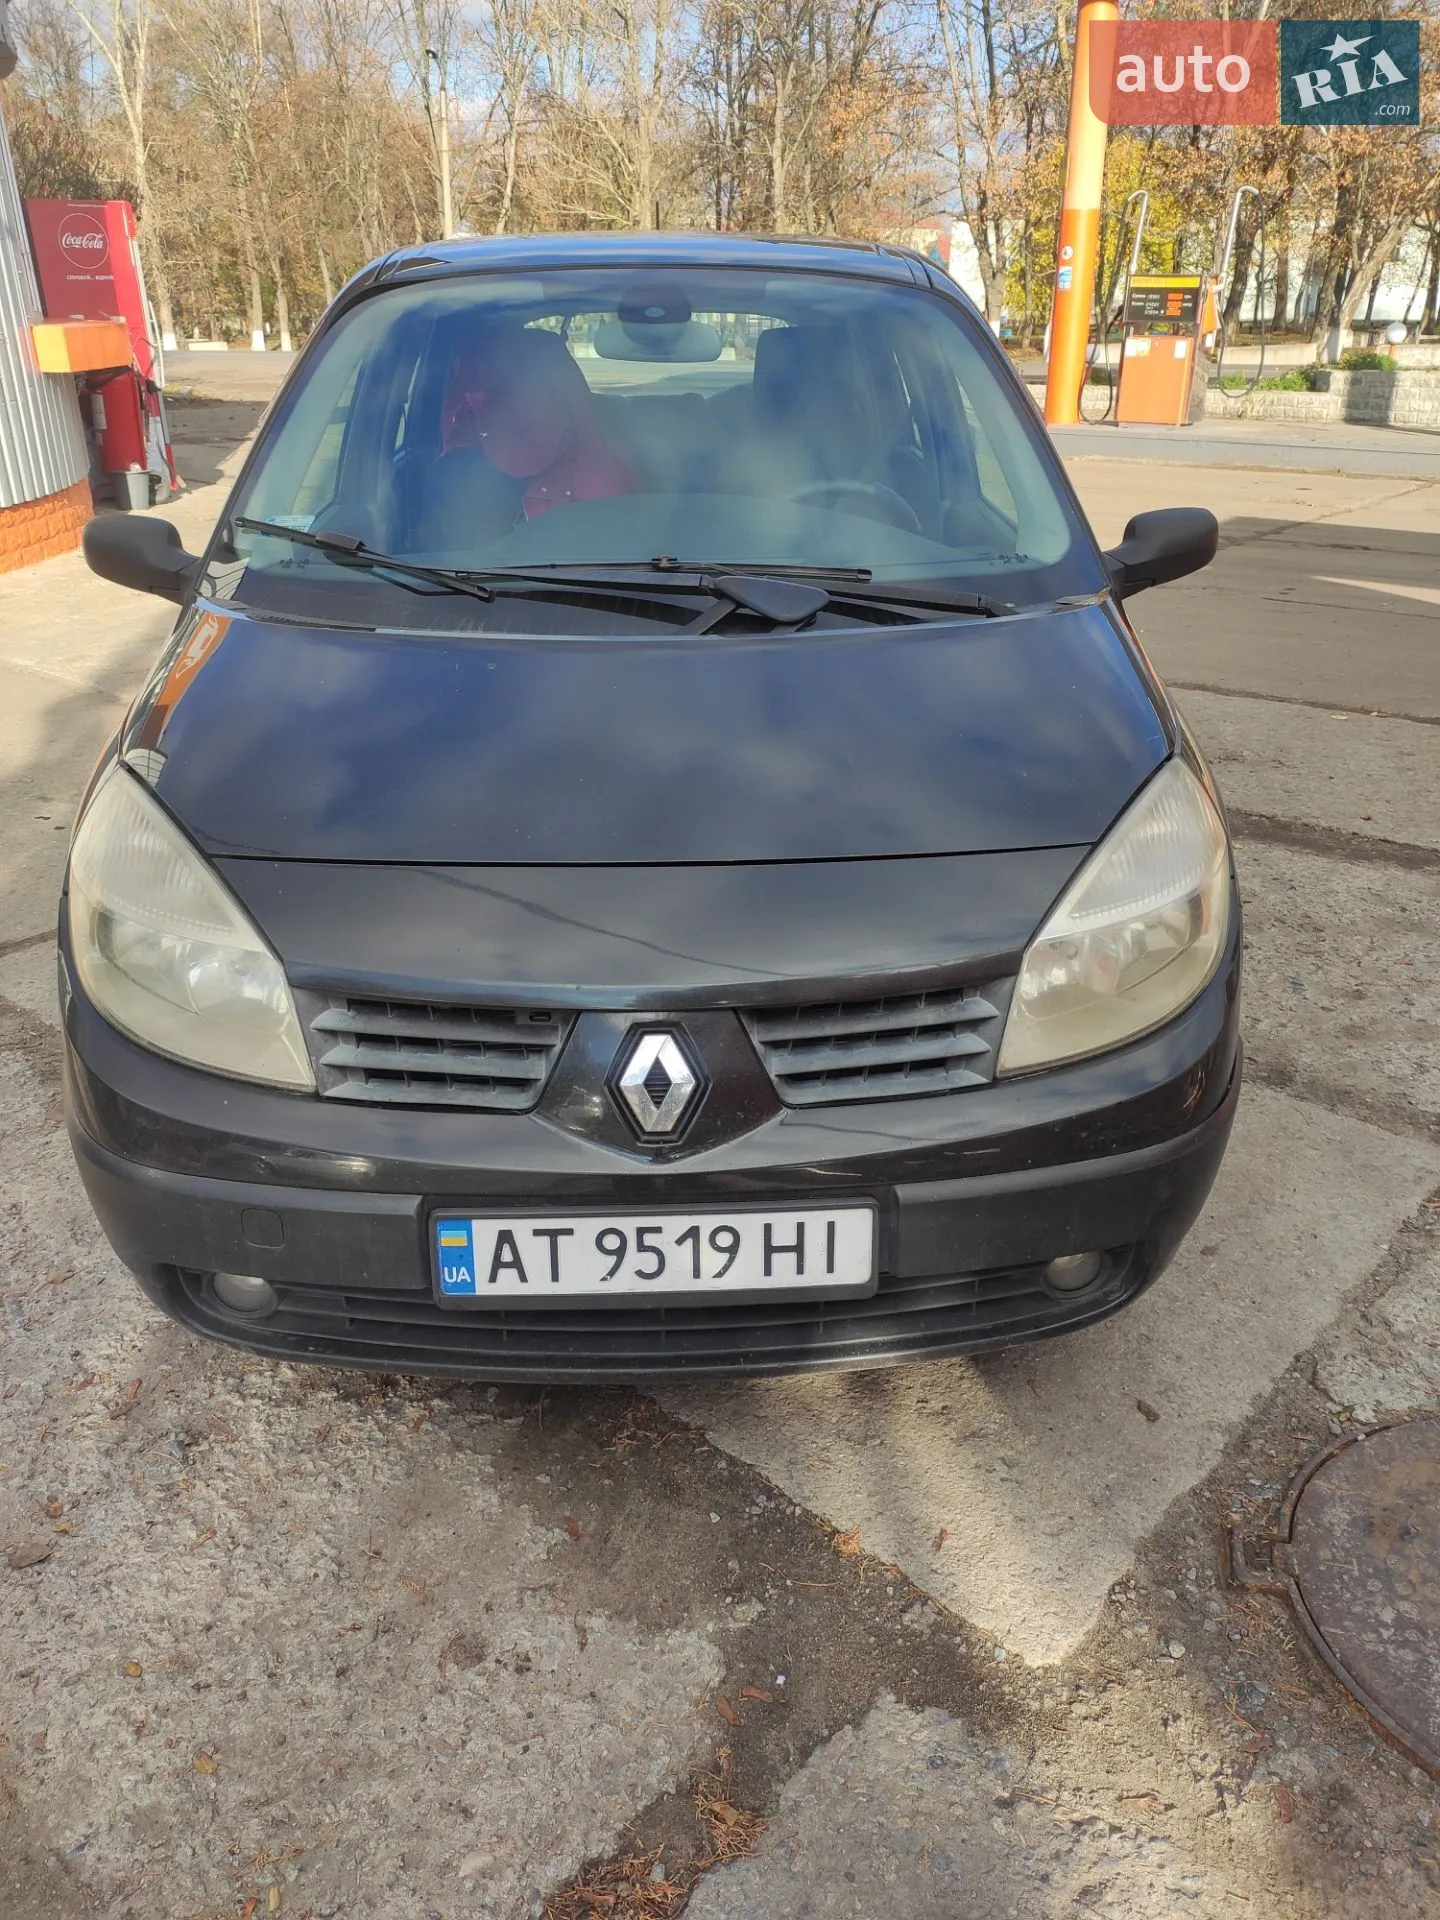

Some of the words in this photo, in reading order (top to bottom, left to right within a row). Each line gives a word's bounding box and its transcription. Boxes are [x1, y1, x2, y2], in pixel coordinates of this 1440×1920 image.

[62, 232, 104, 249] Coca-Cola
[488, 1227, 574, 1283] AT
[594, 1224, 741, 1283] 9519
[764, 1220, 836, 1277] HI
[443, 1267, 471, 1284] UA
